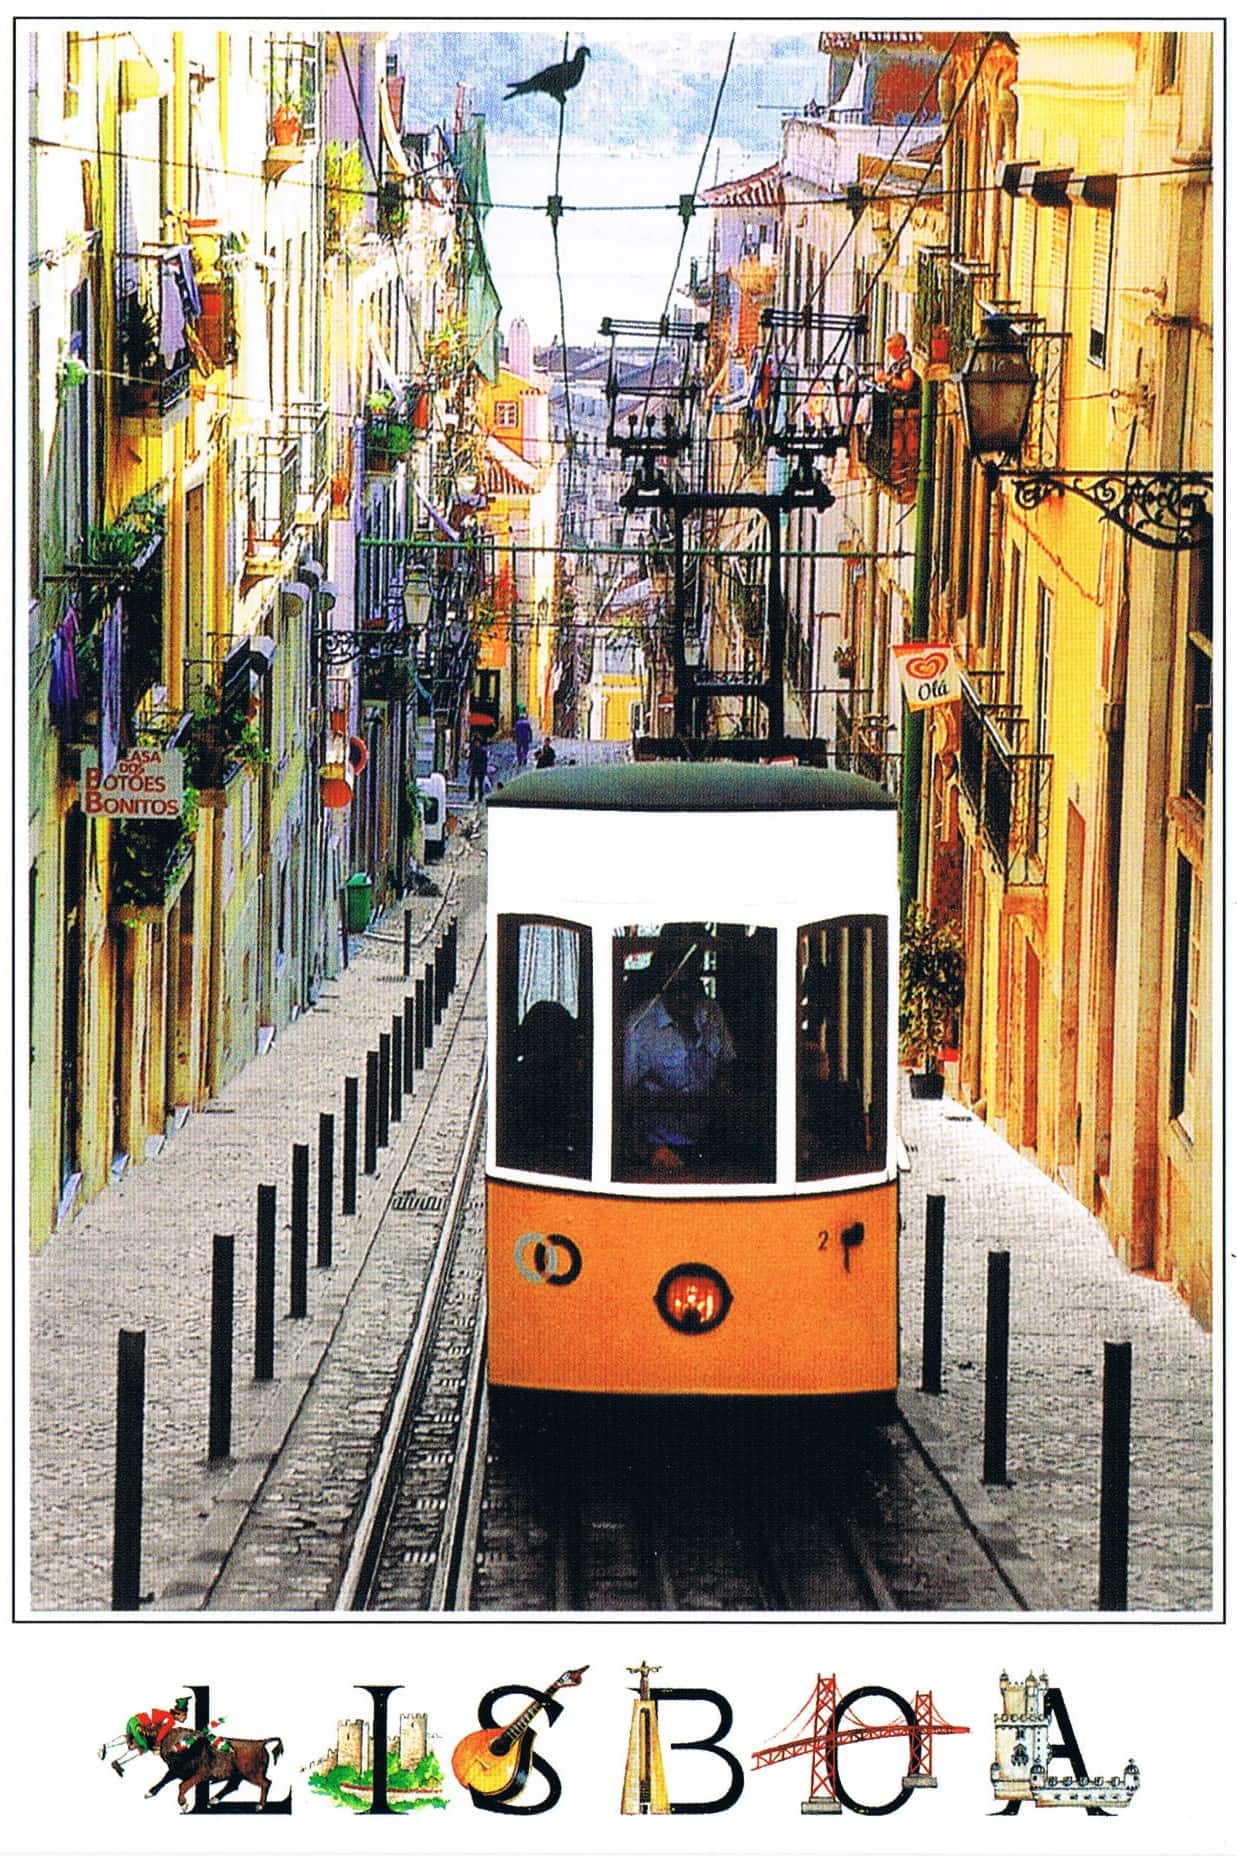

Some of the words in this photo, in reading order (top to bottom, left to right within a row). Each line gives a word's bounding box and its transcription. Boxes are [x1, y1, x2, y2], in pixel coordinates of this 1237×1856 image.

[918, 679, 949, 701] Olá
[123, 750, 161, 763] ASA
[86, 791, 179, 815] BONITOS
[818, 1229, 829, 1252] 2
